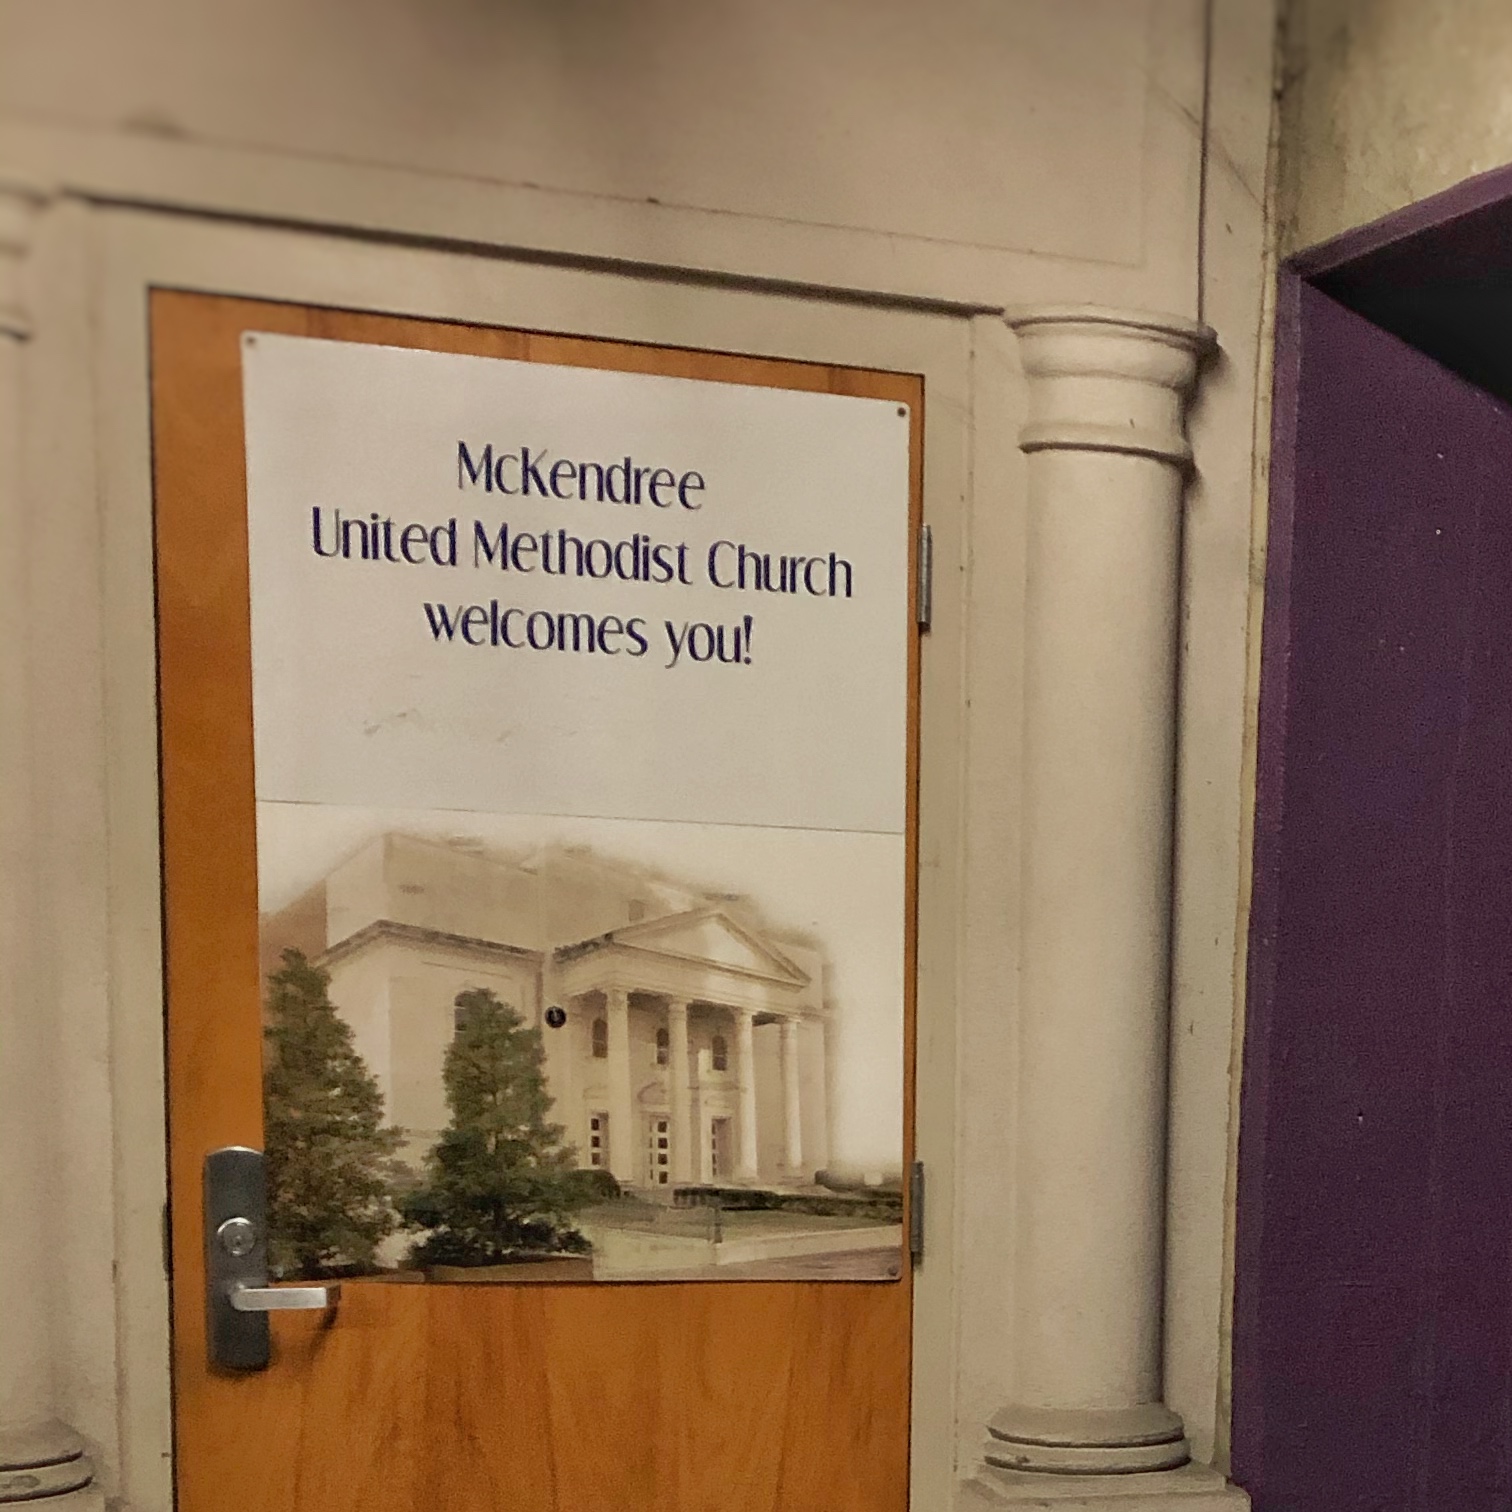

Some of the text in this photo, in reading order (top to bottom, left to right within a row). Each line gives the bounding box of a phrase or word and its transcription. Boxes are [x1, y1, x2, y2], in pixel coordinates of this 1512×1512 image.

[456, 441, 706, 510] McKendree
[311, 507, 853, 597] United Methodist Church
[423, 599, 754, 669] welcomes you!
